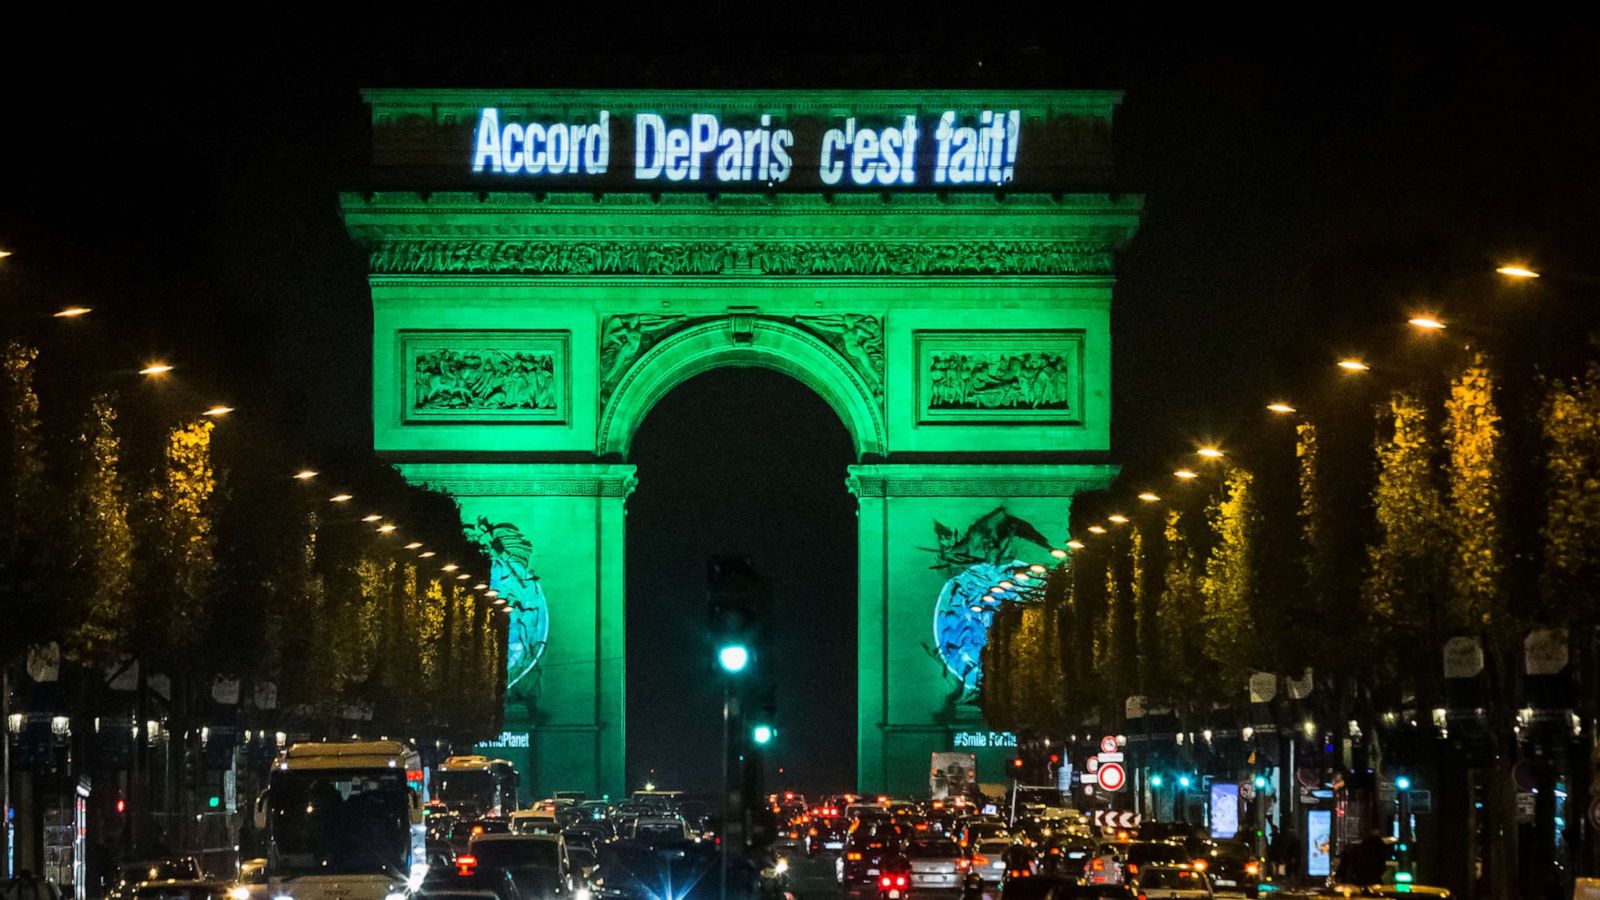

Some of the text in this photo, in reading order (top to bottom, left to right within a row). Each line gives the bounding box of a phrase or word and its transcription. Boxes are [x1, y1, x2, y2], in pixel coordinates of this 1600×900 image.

[472, 107, 1021, 185] Accord DeParis c'est fait!
[954, 732, 987, 747] #Smile
